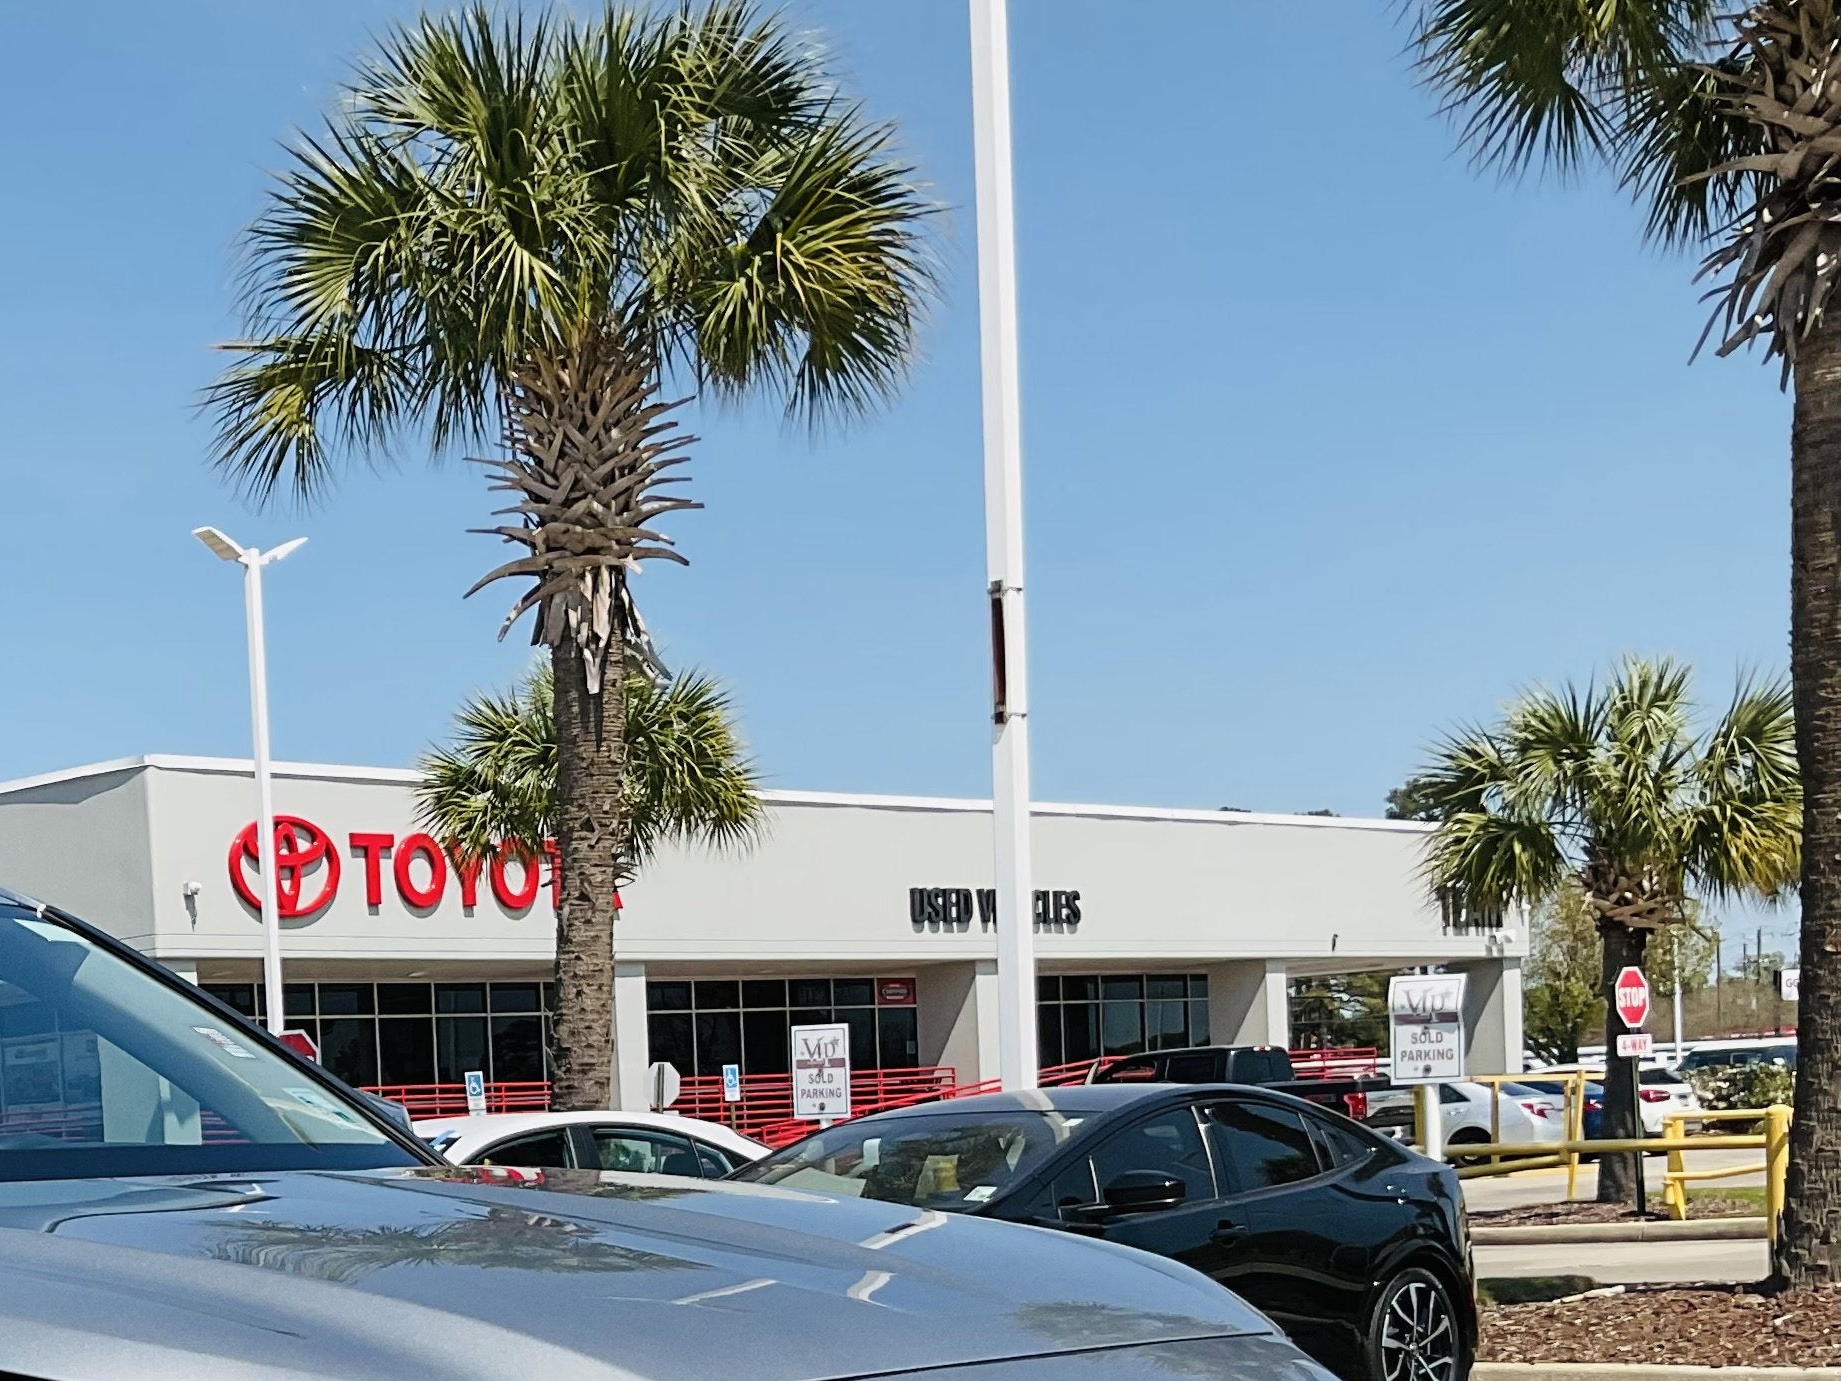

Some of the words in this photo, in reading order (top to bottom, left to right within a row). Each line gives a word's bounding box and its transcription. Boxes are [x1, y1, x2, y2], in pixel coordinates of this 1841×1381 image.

[909, 887, 973, 923] USED
[1618, 986, 1646, 1008] STOP
[1411, 1032, 1444, 1044] SOLD
[1621, 1039, 1648, 1051] 4-WAY
[1400, 1049, 1454, 1062] PARKING
[808, 1072, 834, 1084] SOLD
[800, 1088, 842, 1099] PARKING
